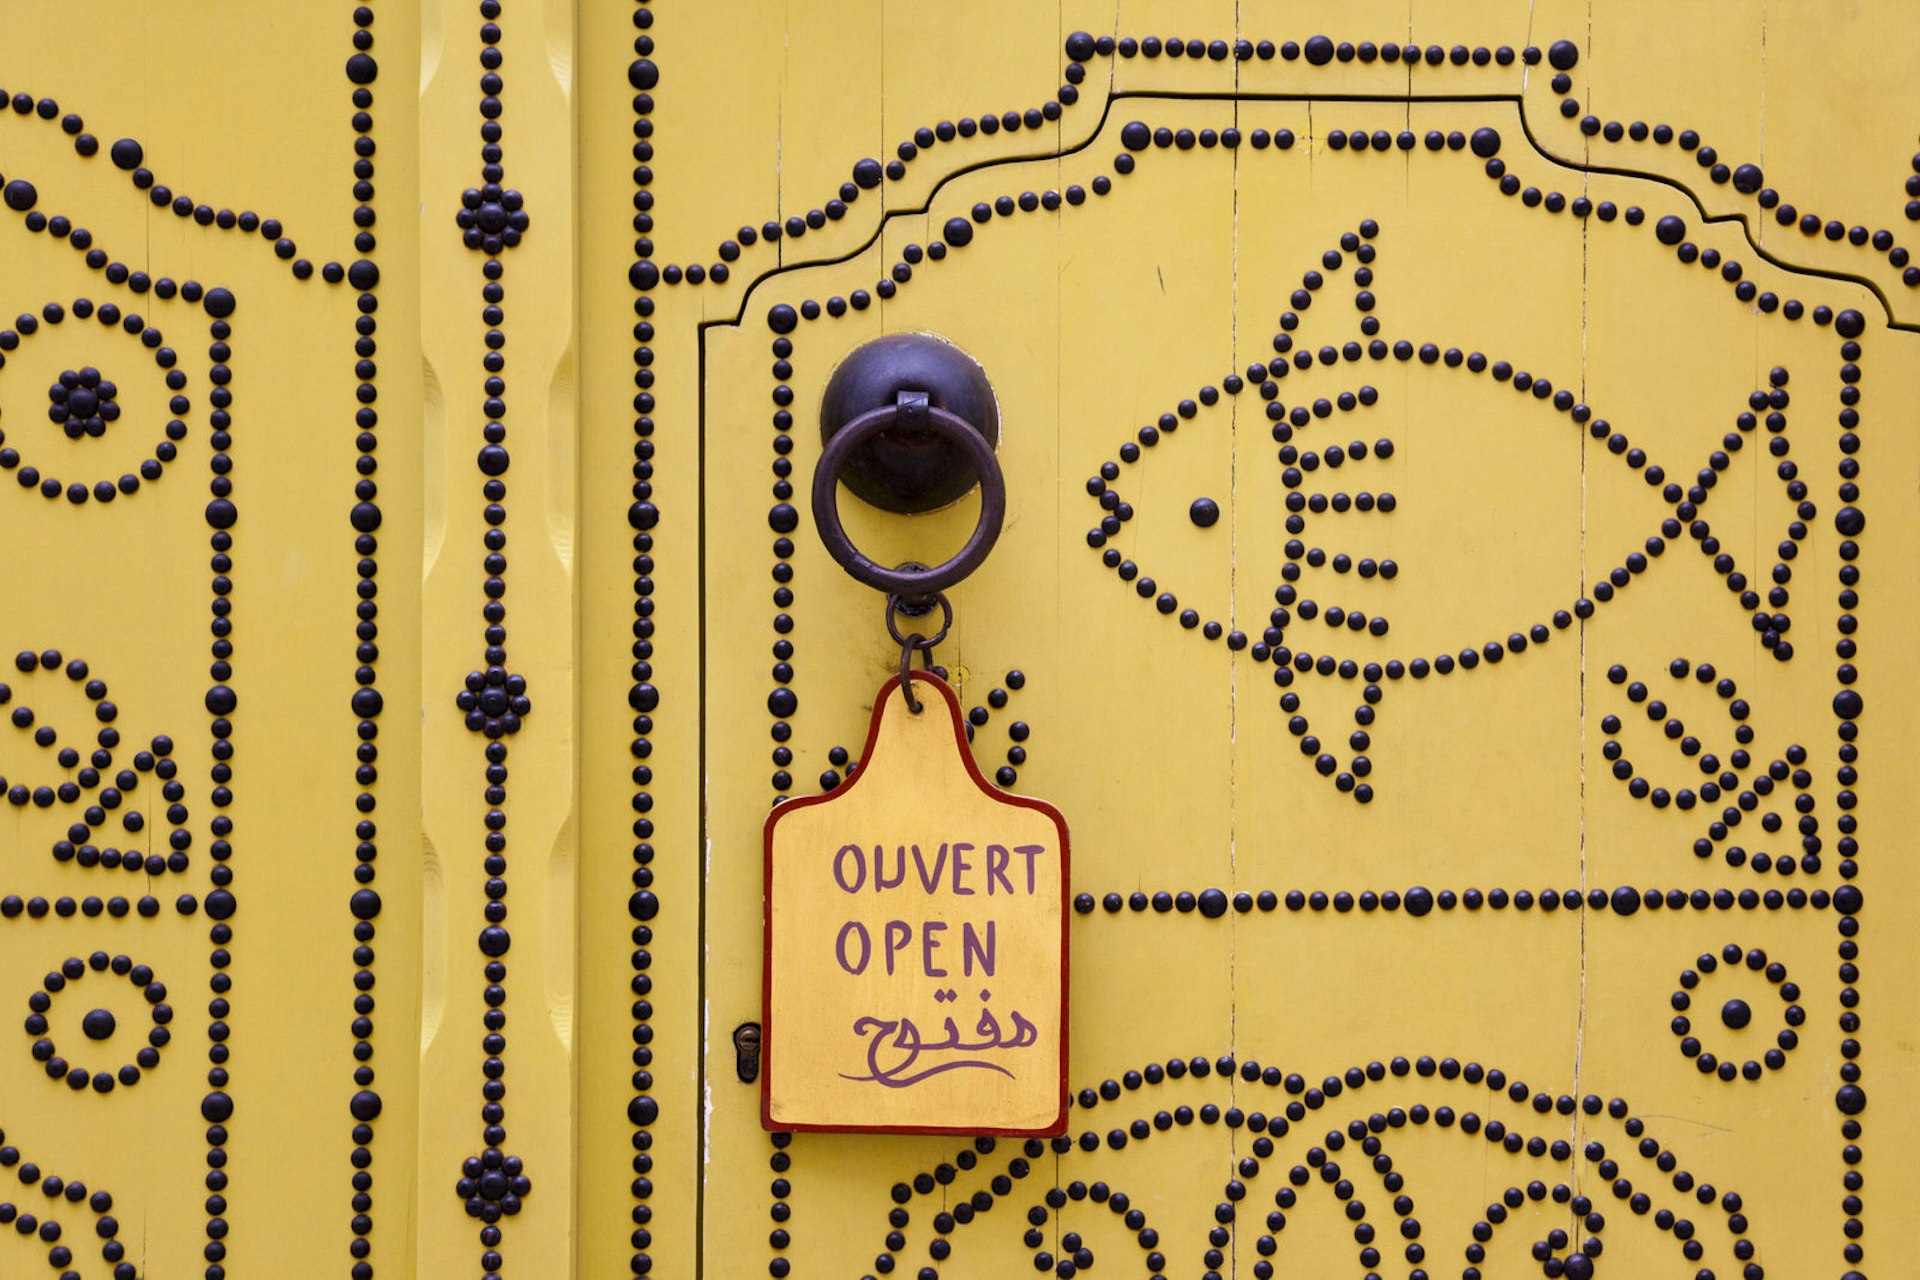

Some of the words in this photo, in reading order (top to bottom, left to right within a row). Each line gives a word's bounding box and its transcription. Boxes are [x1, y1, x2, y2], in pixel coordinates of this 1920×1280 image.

[833, 843, 1045, 896] OUVERT
[836, 921, 996, 977] OPEN
[838, 988, 1038, 1088] مفتوح
